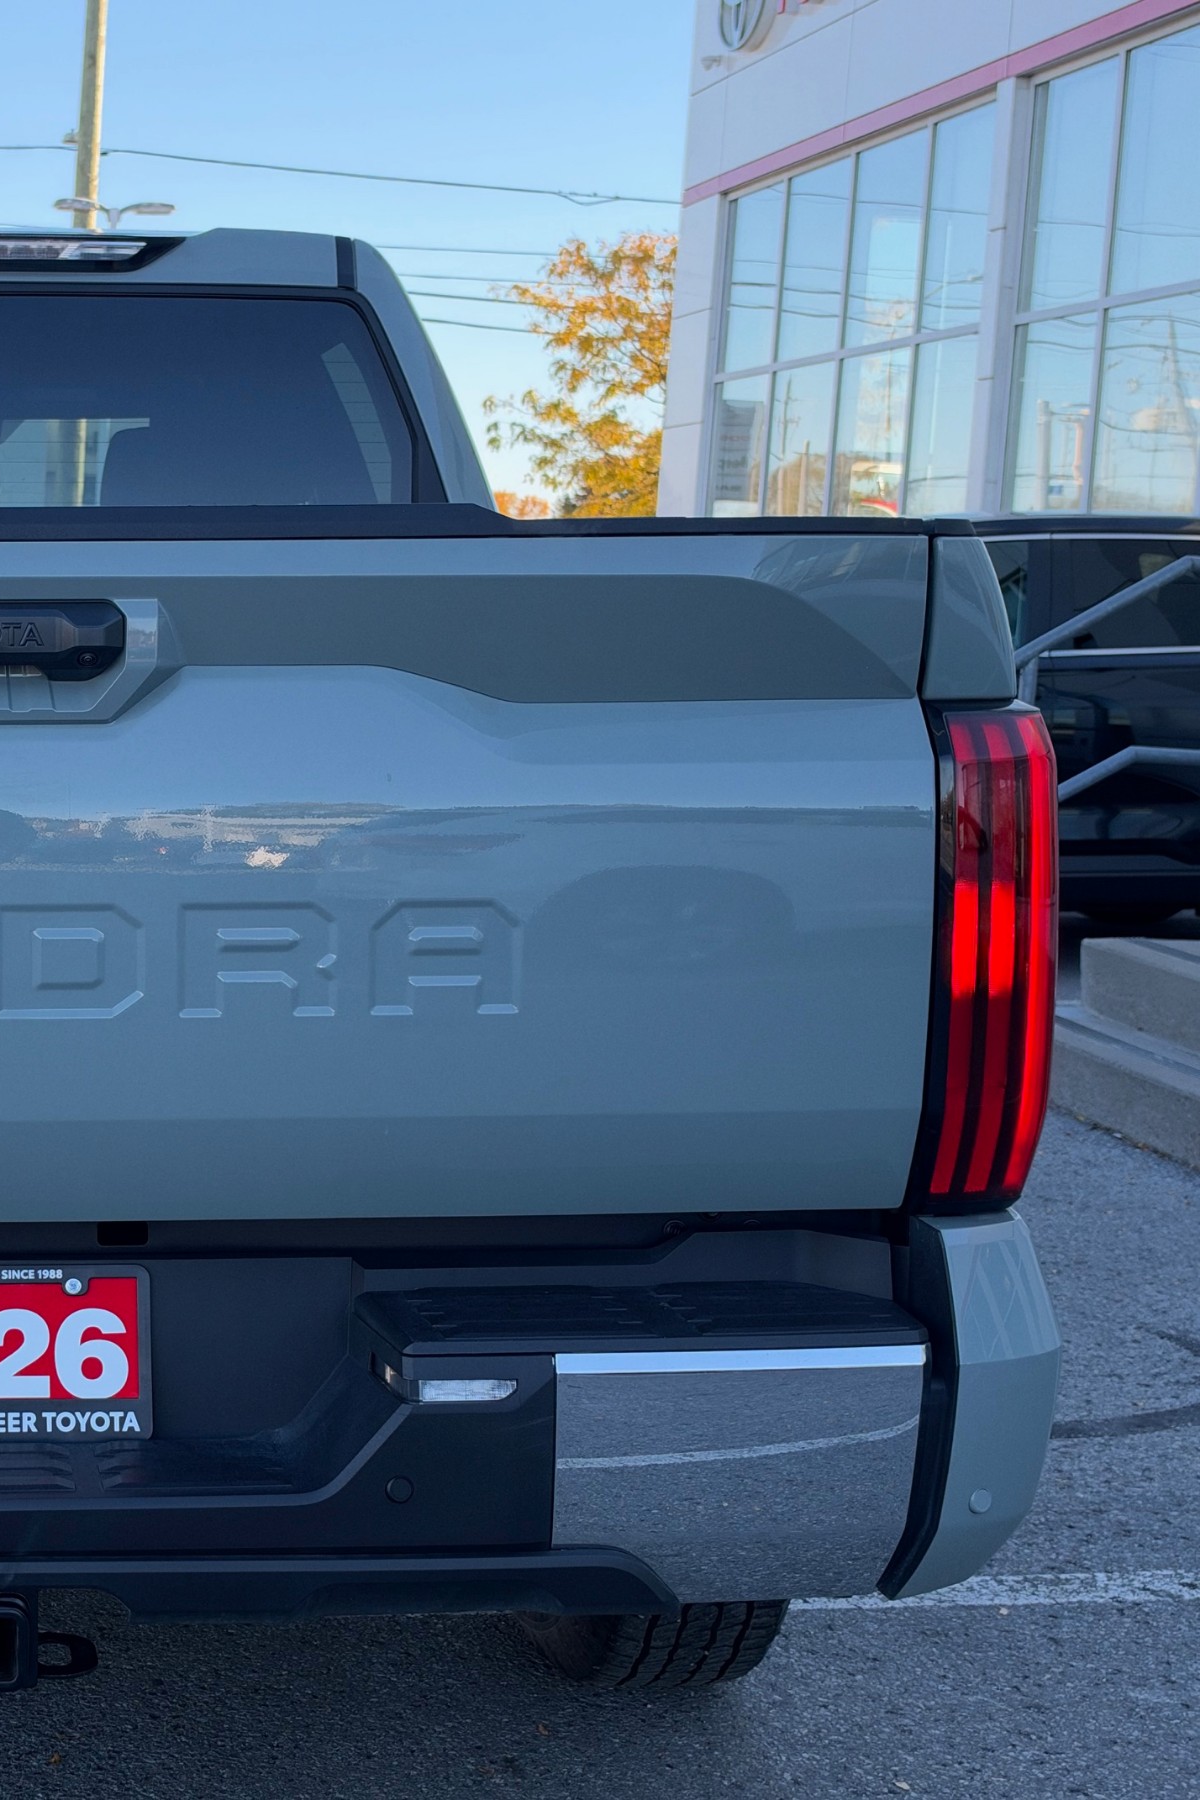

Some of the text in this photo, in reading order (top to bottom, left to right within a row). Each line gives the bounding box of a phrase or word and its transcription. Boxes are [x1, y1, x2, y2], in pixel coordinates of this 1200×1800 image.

[1, 1269, 35, 1280] SINCE
[37, 1269, 63, 1279] 1988
[41, 1411, 141, 1432] TOYOTA
